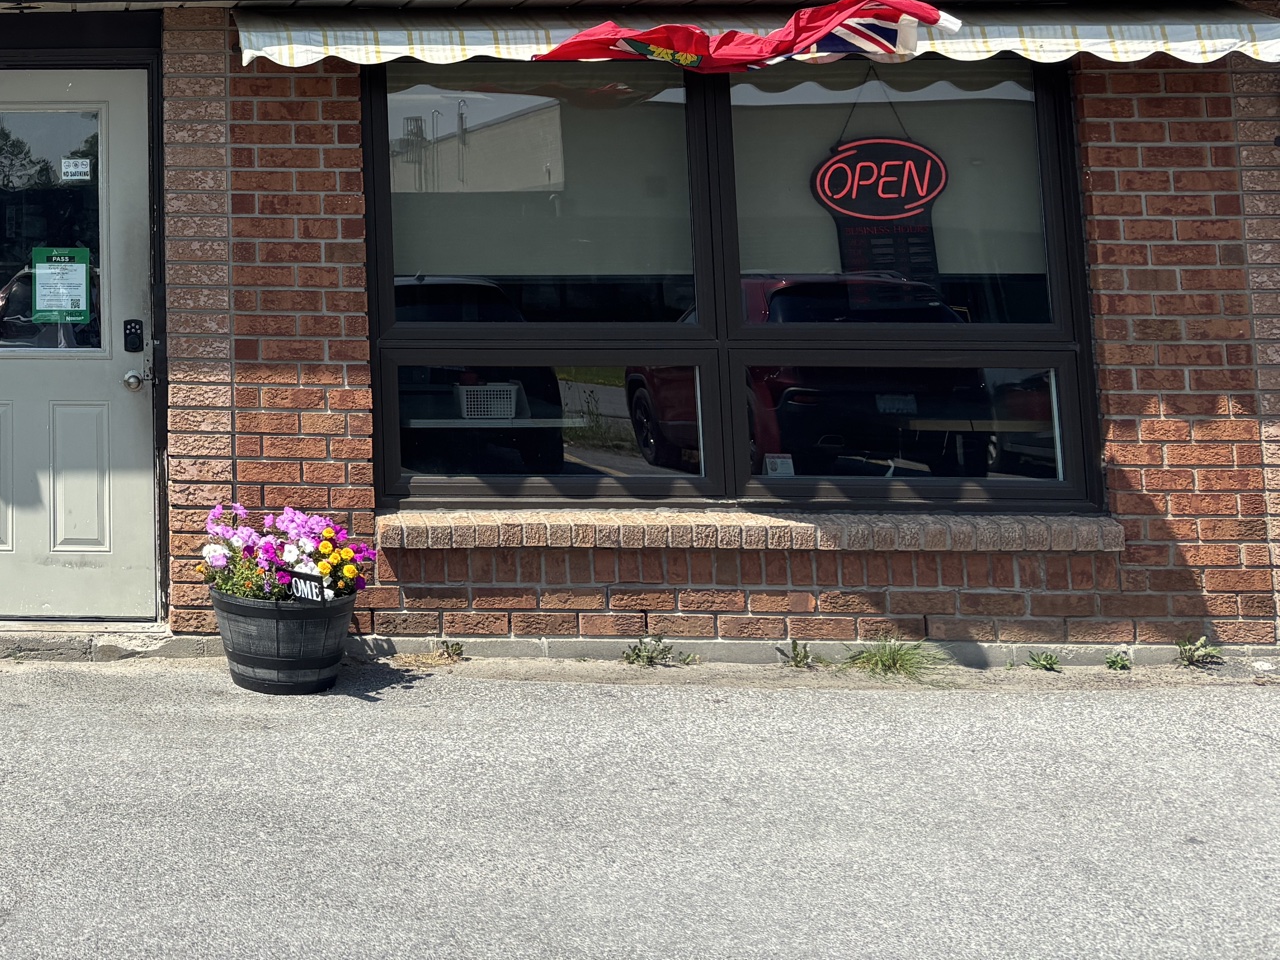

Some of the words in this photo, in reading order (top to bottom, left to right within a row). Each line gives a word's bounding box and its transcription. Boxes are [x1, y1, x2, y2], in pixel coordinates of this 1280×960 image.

[63, 170, 70, 178] NO
[70, 170, 90, 178] SMOKING
[823, 159, 931, 200] OPEN
[844, 225, 890, 235] BUSINESS
[893, 224, 929, 234] HOURS
